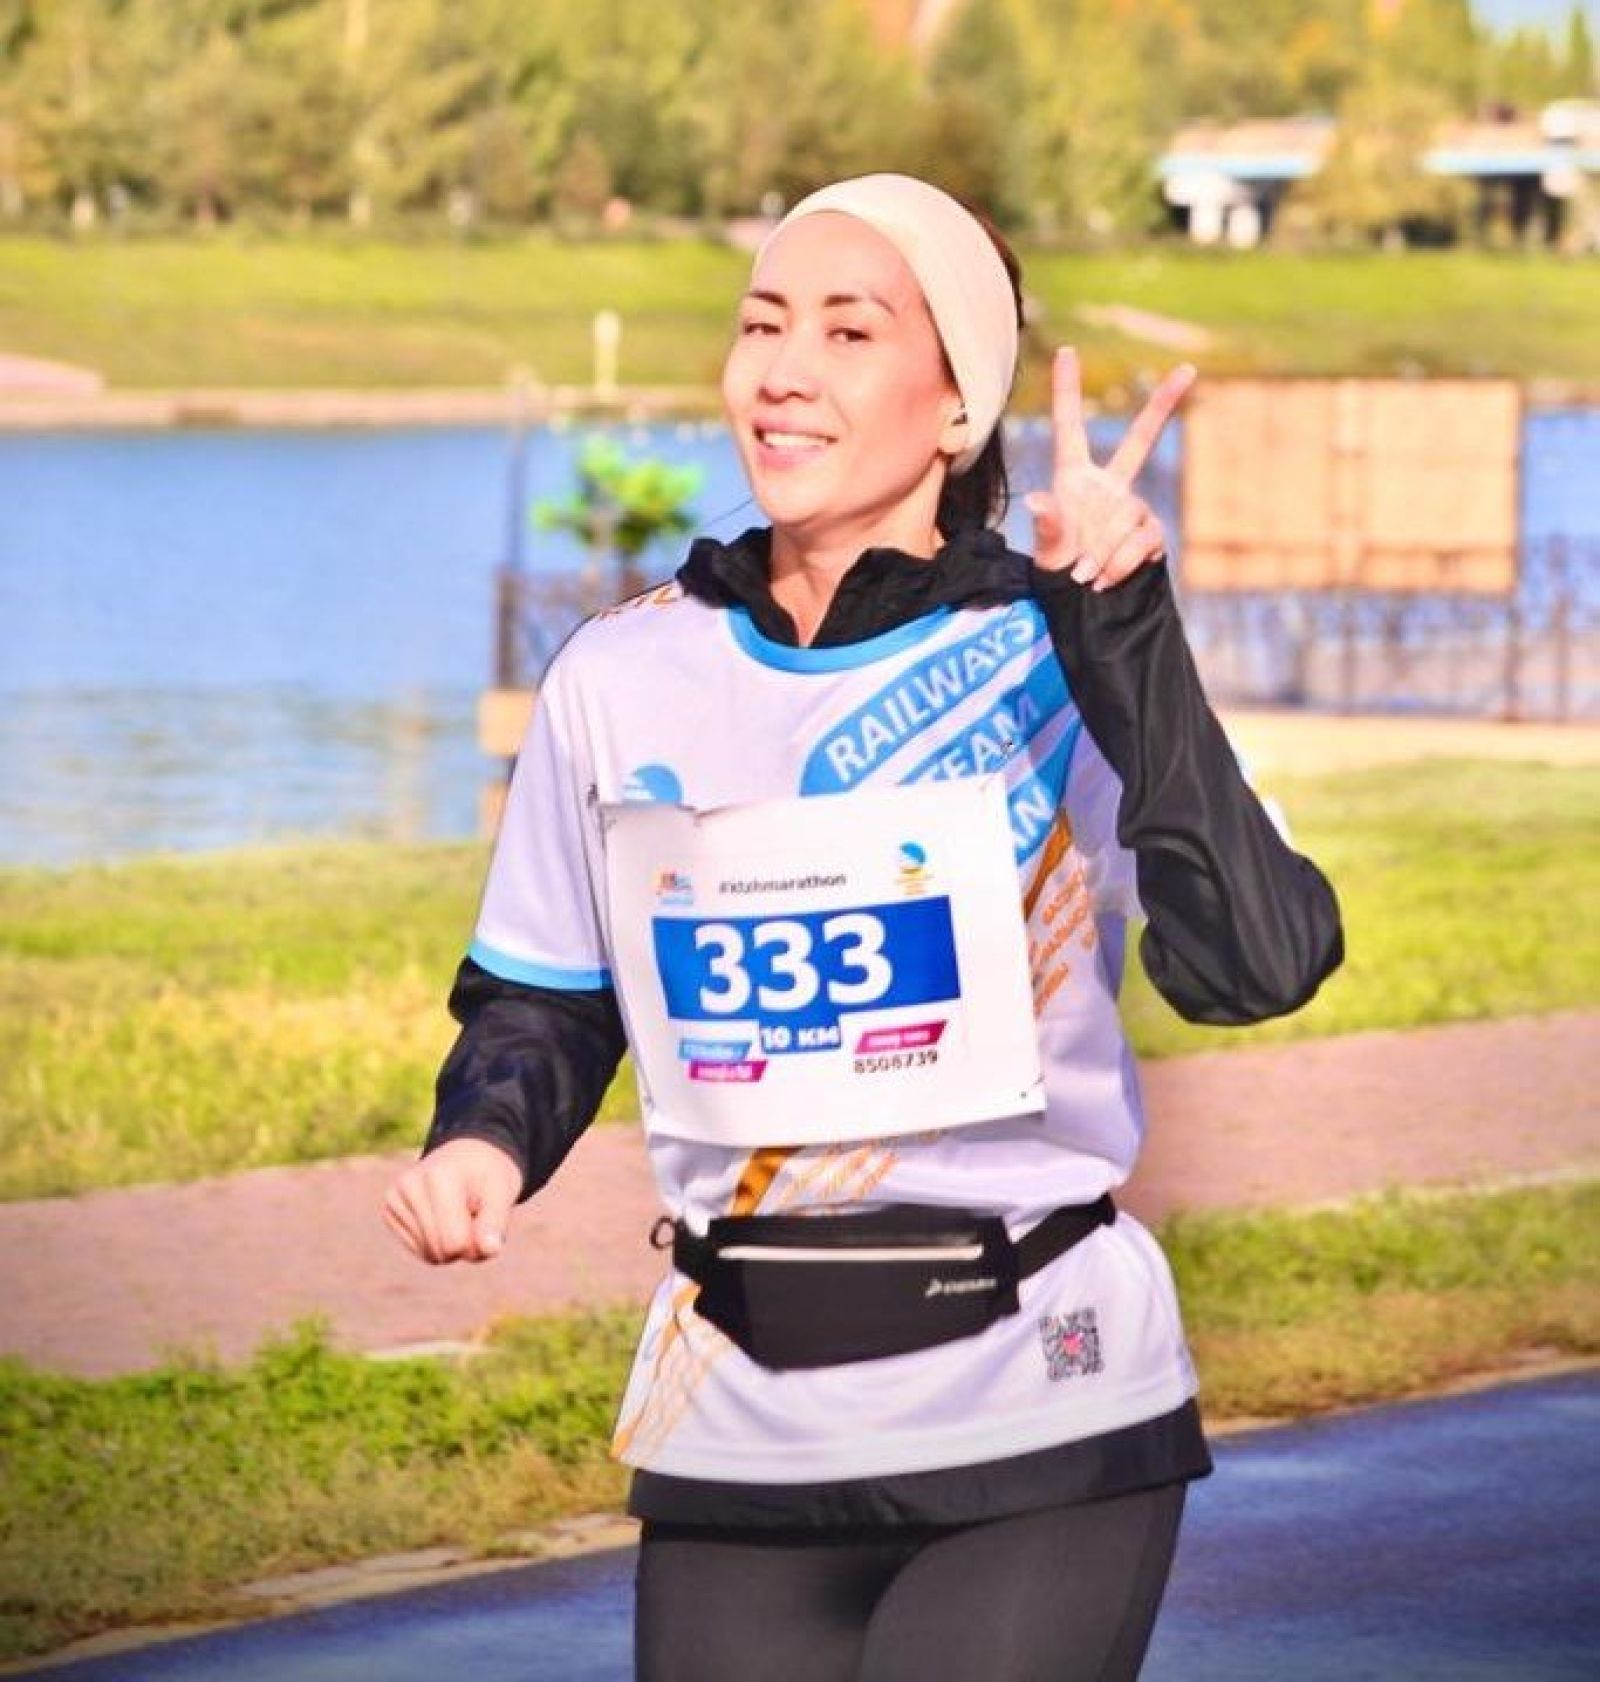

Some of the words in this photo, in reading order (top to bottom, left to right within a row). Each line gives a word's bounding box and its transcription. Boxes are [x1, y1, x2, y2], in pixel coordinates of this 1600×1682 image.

[823, 616, 1036, 784] RAILWAYS
[694, 913, 893, 1013] 333
[759, 1026, 791, 1049] 10
